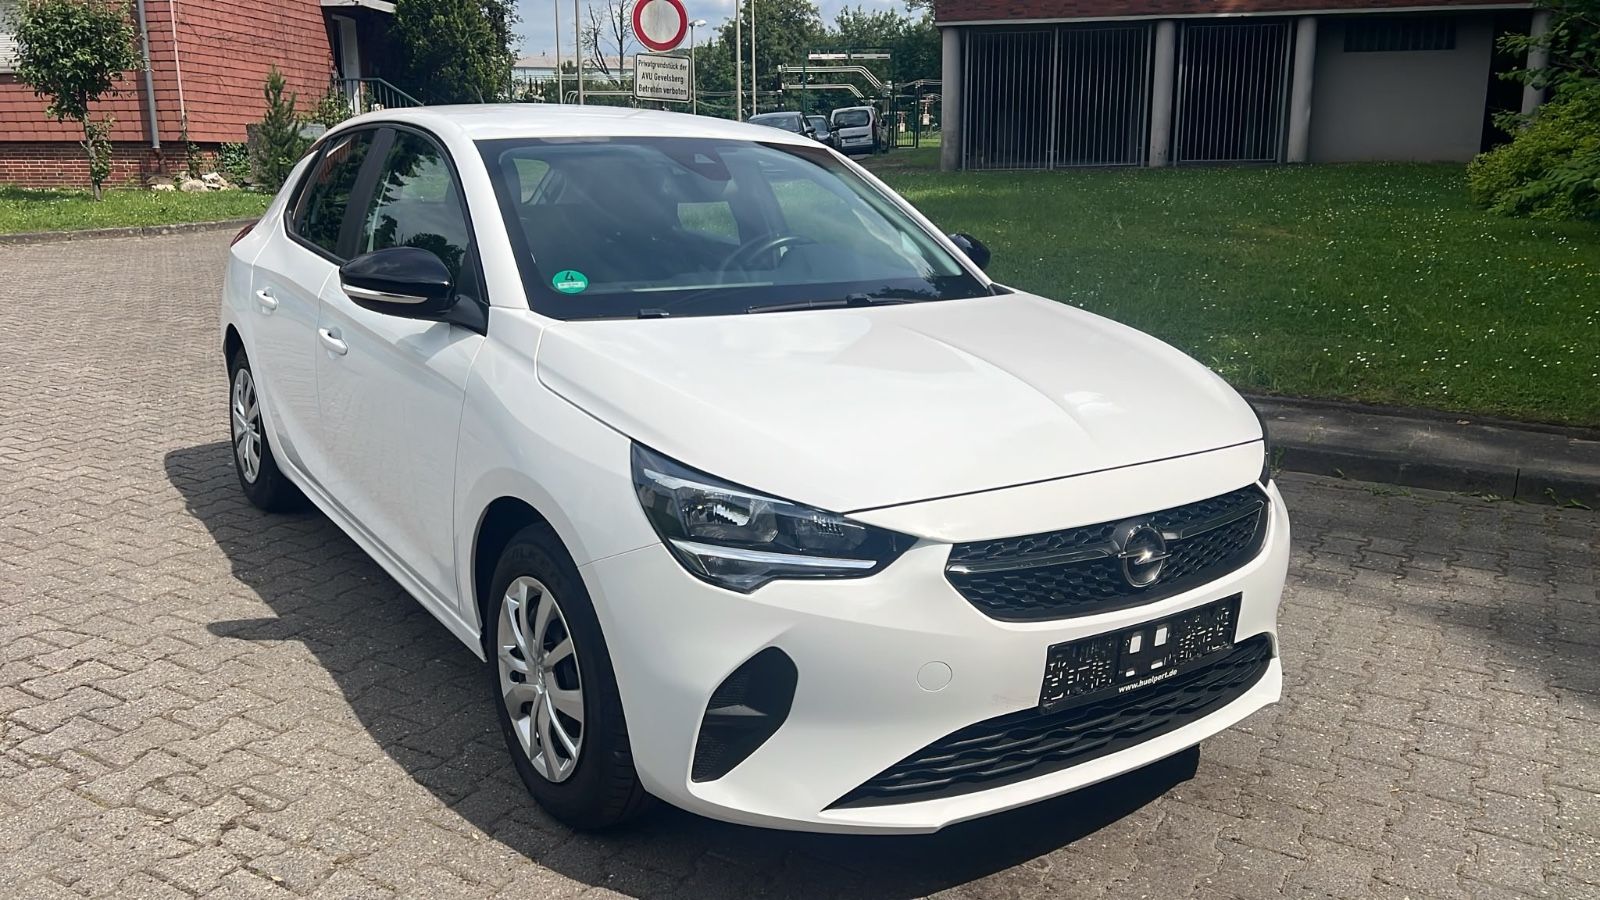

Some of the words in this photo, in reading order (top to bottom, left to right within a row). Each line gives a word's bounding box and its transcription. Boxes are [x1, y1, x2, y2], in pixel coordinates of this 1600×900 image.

[641, 72, 653, 80] AVU
[653, 73, 684, 84] Gevelsberg
[638, 84, 662, 93] Betreten
[663, 86, 687, 95] verboten
[565, 271, 575, 282] 4
[1118, 669, 1178, 693] www.huelpert.de
